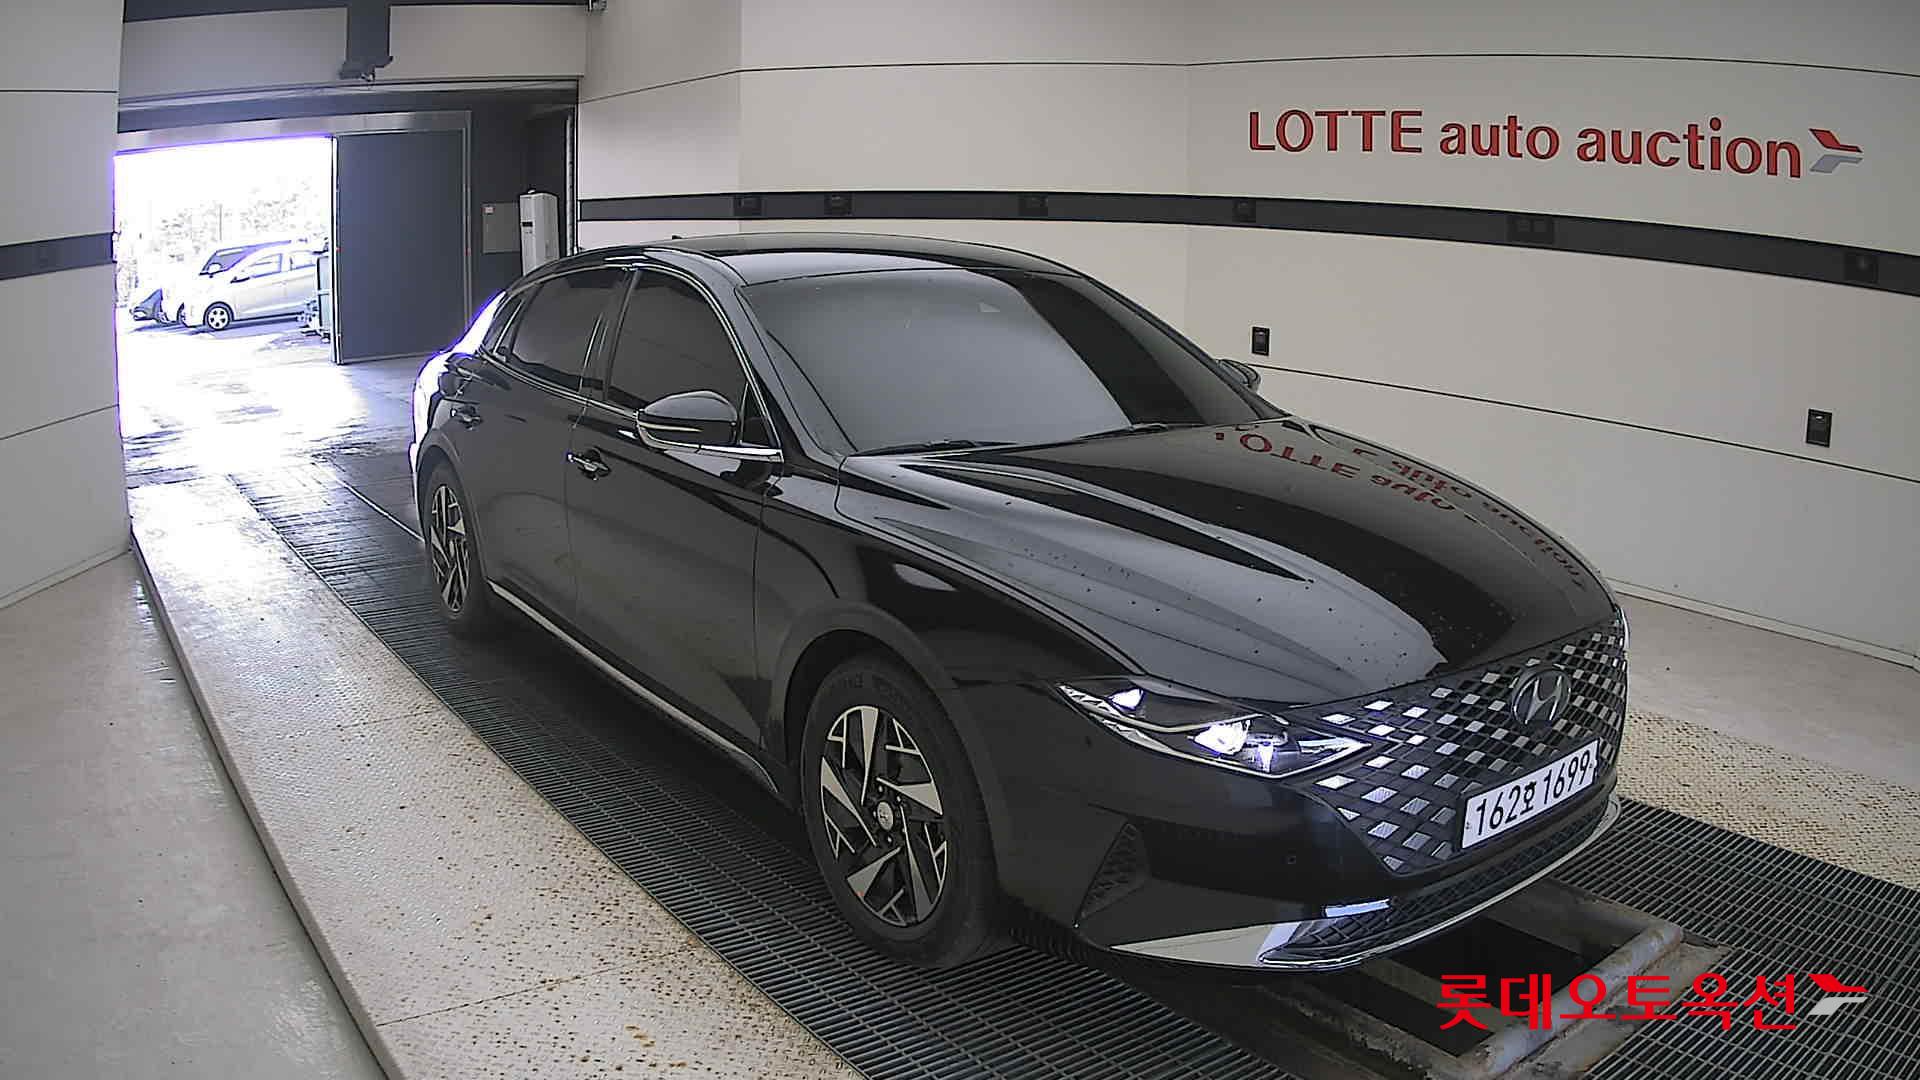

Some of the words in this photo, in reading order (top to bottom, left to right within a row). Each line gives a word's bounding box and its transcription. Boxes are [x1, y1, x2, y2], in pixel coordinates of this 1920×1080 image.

[1248, 110, 1422, 154] LOTTE
[1439, 115, 1560, 160] auto
[1576, 117, 1802, 179] auction
[1475, 781, 1537, 836] 162호
[1543, 750, 1591, 805] 1699
